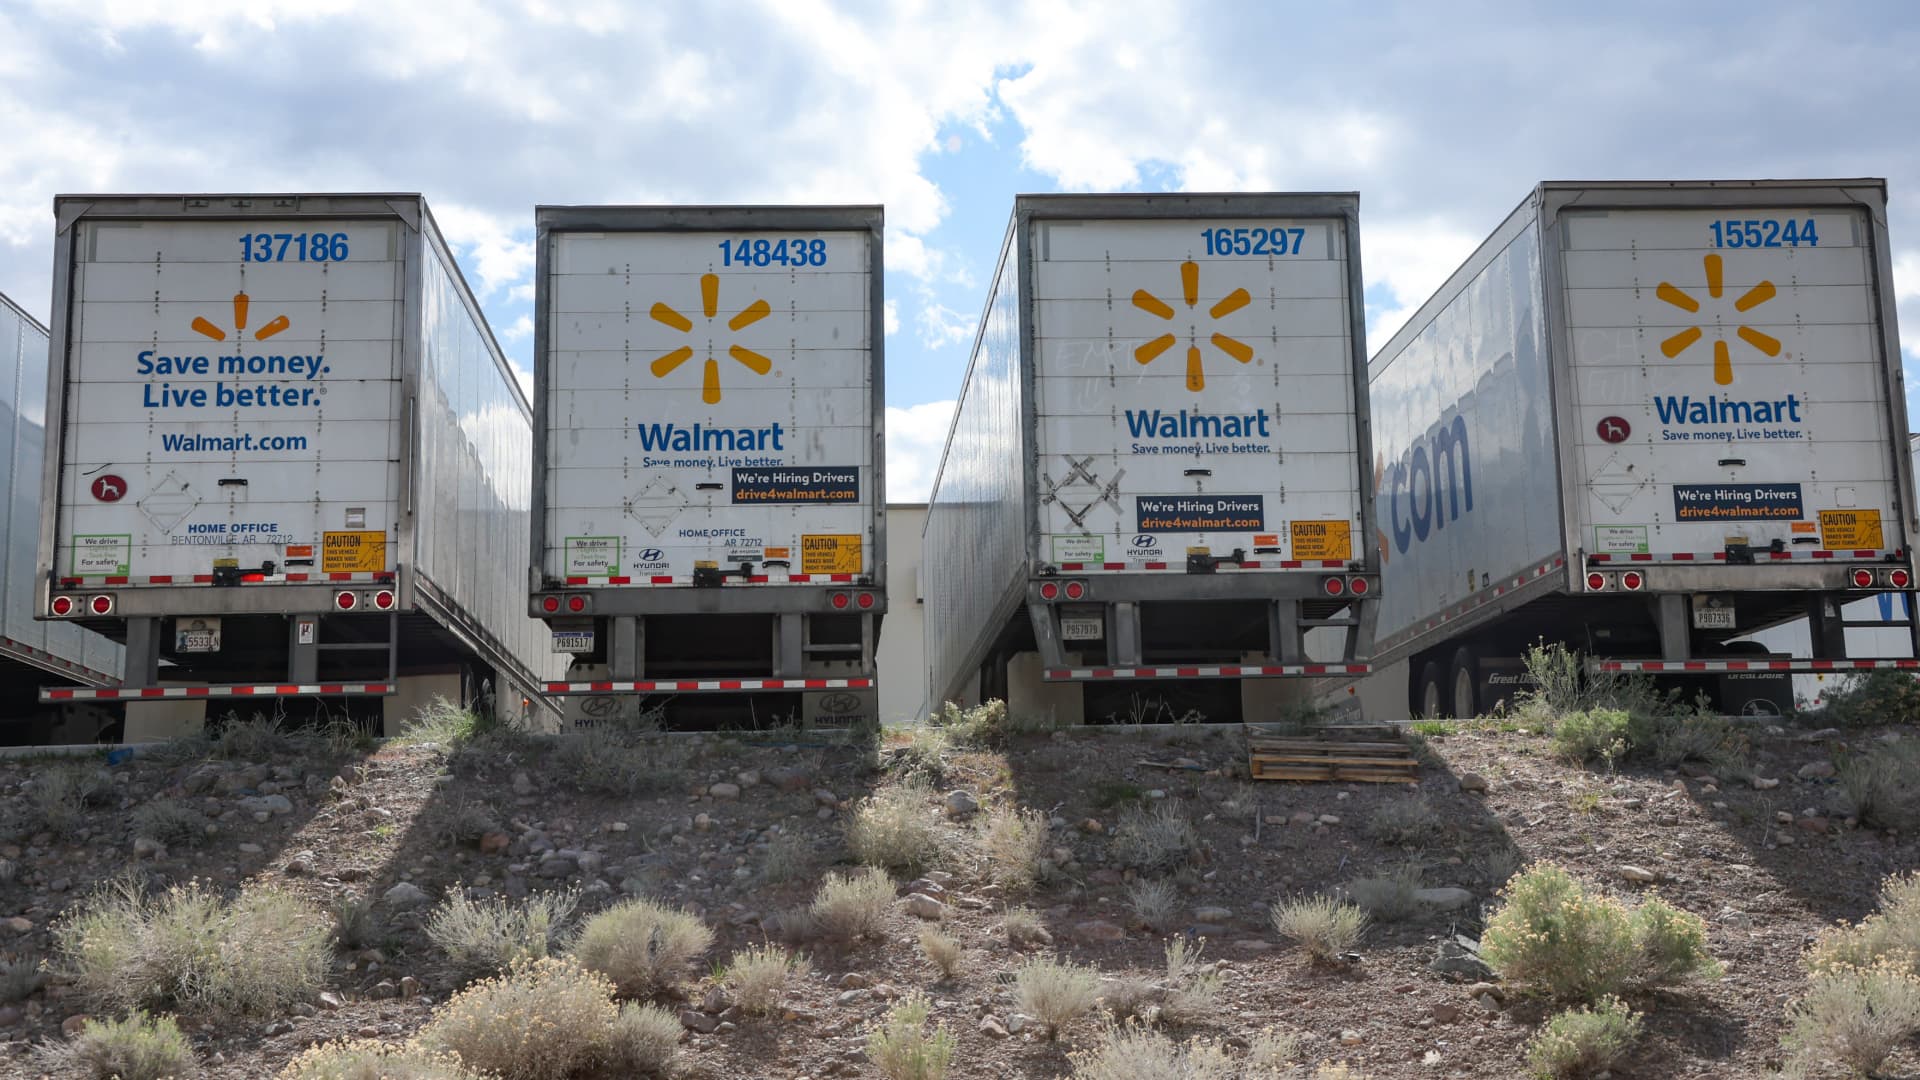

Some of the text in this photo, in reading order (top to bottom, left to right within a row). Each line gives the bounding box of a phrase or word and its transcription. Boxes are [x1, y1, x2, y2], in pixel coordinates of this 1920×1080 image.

[1709, 219, 1818, 248] 155244
[239, 233, 348, 262] 137186
[1201, 228, 1305, 255] 165297
[719, 239, 826, 267] 148438
[137, 351, 330, 379] Save money.
[143, 382, 321, 408] Live better.
[1654, 394, 1801, 424] Walmart
[1125, 409, 1270, 438] Walmart
[638, 422, 784, 452] Walmart
[1662, 428, 1803, 442] Save money. Live better.
[162, 433, 307, 452] Walmart.com
[1132, 442, 1271, 456] Save money. Live better.
[643, 455, 784, 470] Save money. Live better.
[737, 472, 855, 486] We're Hiring Drivers
[736, 488, 855, 500] drive4walmart.com
[1678, 489, 1797, 503] We're Hiring Drivers
[1141, 501, 1259, 514] We're Hiring Drivers
[1679, 505, 1799, 518] drive4walmart.com
[1141, 517, 1260, 529] drive4walmart.com
[1823, 513, 1856, 525] CAUTION
[188, 523, 278, 533] HOME OFFICE
[679, 529, 745, 537] HOME OFFICE
[1293, 524, 1326, 536] CAUTION
[266, 535, 293, 544] 72712
[326, 536, 360, 547] CAUTION
[724, 539, 762, 547] AR 72712
[805, 539, 837, 550] CAUTION
[96, 559, 118, 567] safety
[1488, 673, 1519, 684] Great
